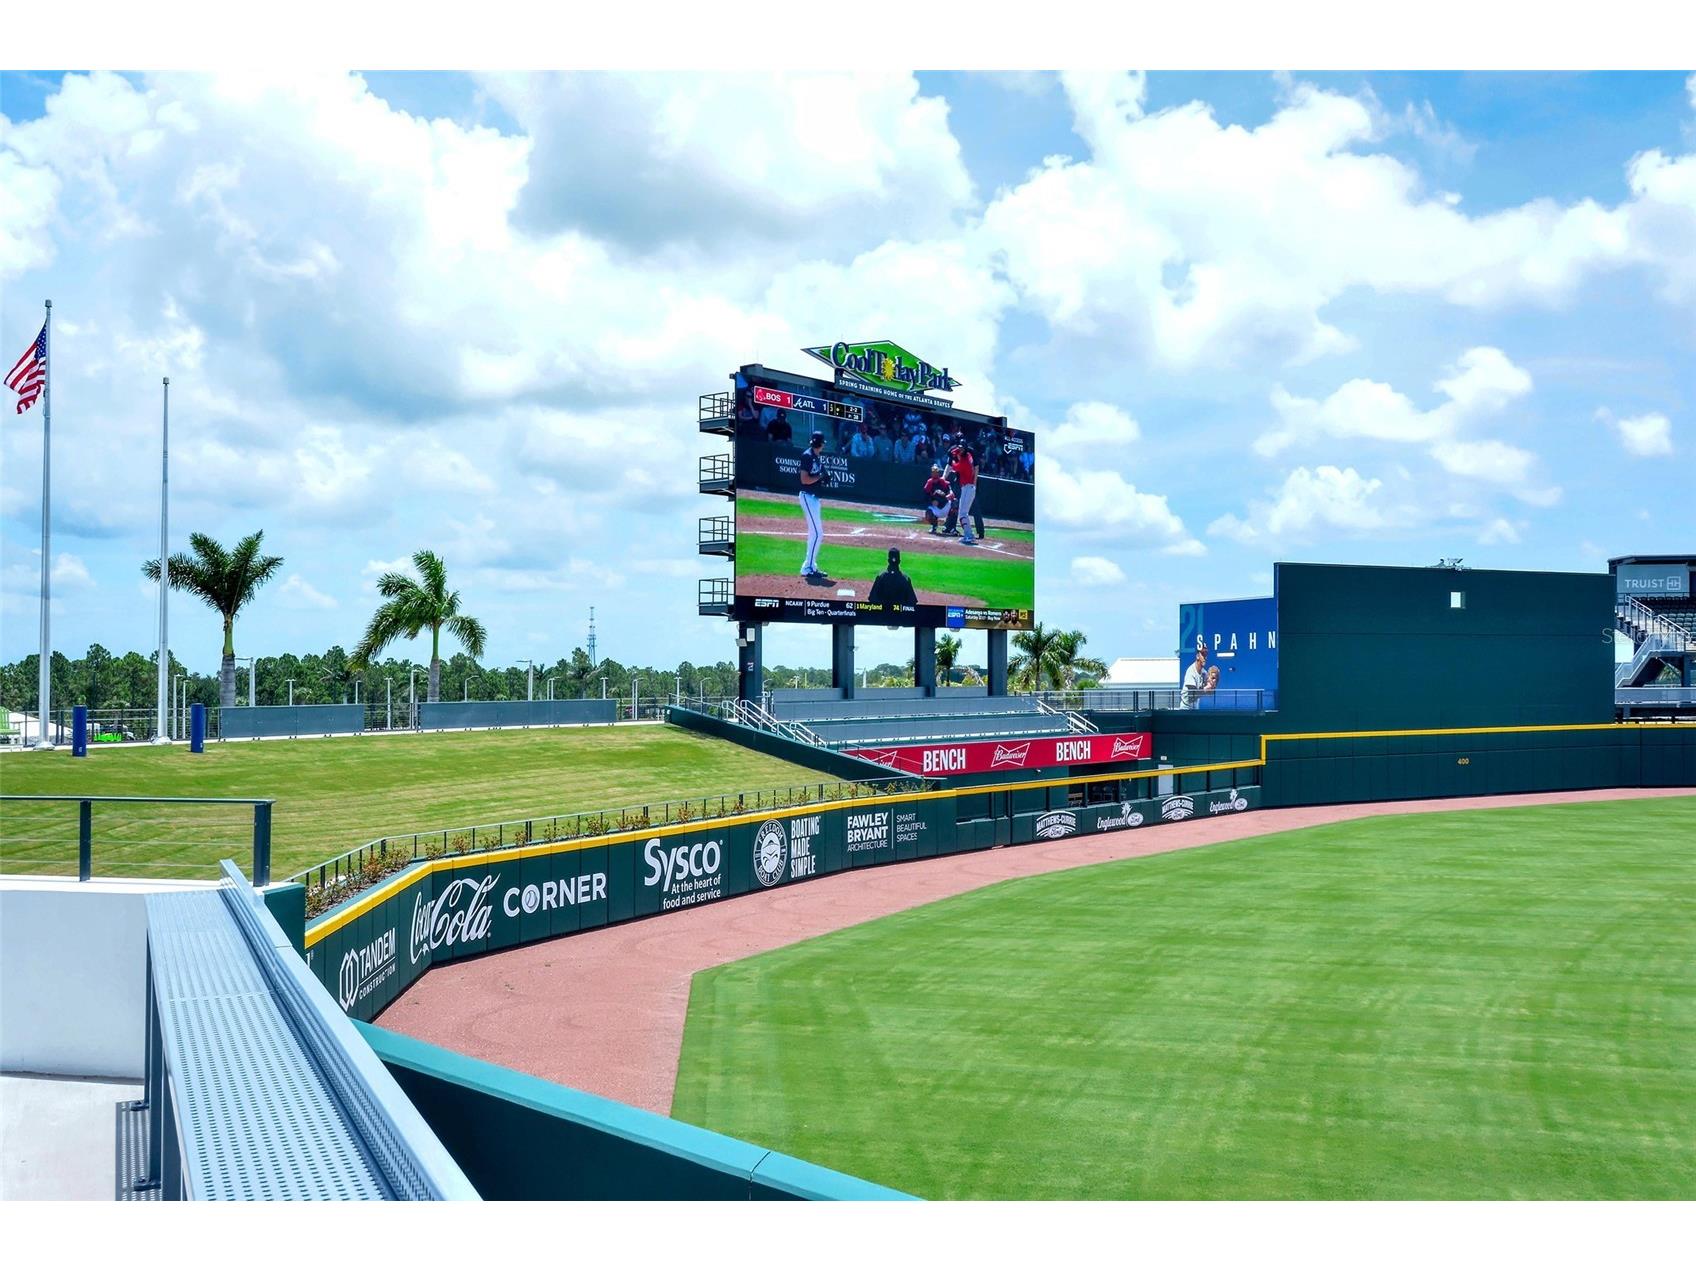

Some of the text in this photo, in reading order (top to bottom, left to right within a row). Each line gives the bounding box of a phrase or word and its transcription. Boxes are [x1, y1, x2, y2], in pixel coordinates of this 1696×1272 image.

[765, 392, 781, 402] BOS
[787, 396, 791, 404] 1
[802, 400, 815, 409] ATL
[823, 403, 827, 411] 1
[839, 380, 858, 389] SPRING
[859, 383, 883, 394] TRAINING
[883, 389, 898, 397] HOME
[913, 396, 933, 406] ATLANTA
[775, 457, 801, 467] COMING
[779, 465, 798, 474] SOON
[1624, 578, 1665, 589] TRUIST
[755, 598, 779, 608] ESPN
[860, 603, 883, 611] Maryland
[1196, 630, 1276, 650] SPAHN
[923, 748, 1027, 773] BENCH Budweiser
[1056, 740, 1140, 762] BENCH Budweiser
[1457, 757, 1470, 765] 400
[1210, 800, 1235, 814] Englewood
[792, 816, 820, 839] BOATING
[847, 812, 888, 829] FAWLEY
[896, 813, 916, 823] SMART
[896, 822, 927, 833] BEAUTIFUL
[1097, 813, 1127, 831] Englewood
[758, 823, 784, 844] FREEDOM
[847, 826, 888, 843] BRYANT
[896, 832, 918, 842] SPACES
[791, 837, 810, 859] MADE
[847, 840, 888, 852] ARCHITECTURE
[758, 859, 784, 882] BOAT CLUB
[791, 855, 816, 878] SIMPLE
[671, 873, 721, 894] At the heart of
[503, 872, 607, 918] CORNER
[663, 888, 721, 910] food and service
[360, 927, 396, 979] TANDEM
[359, 962, 396, 1000] CONSTRUCTION
